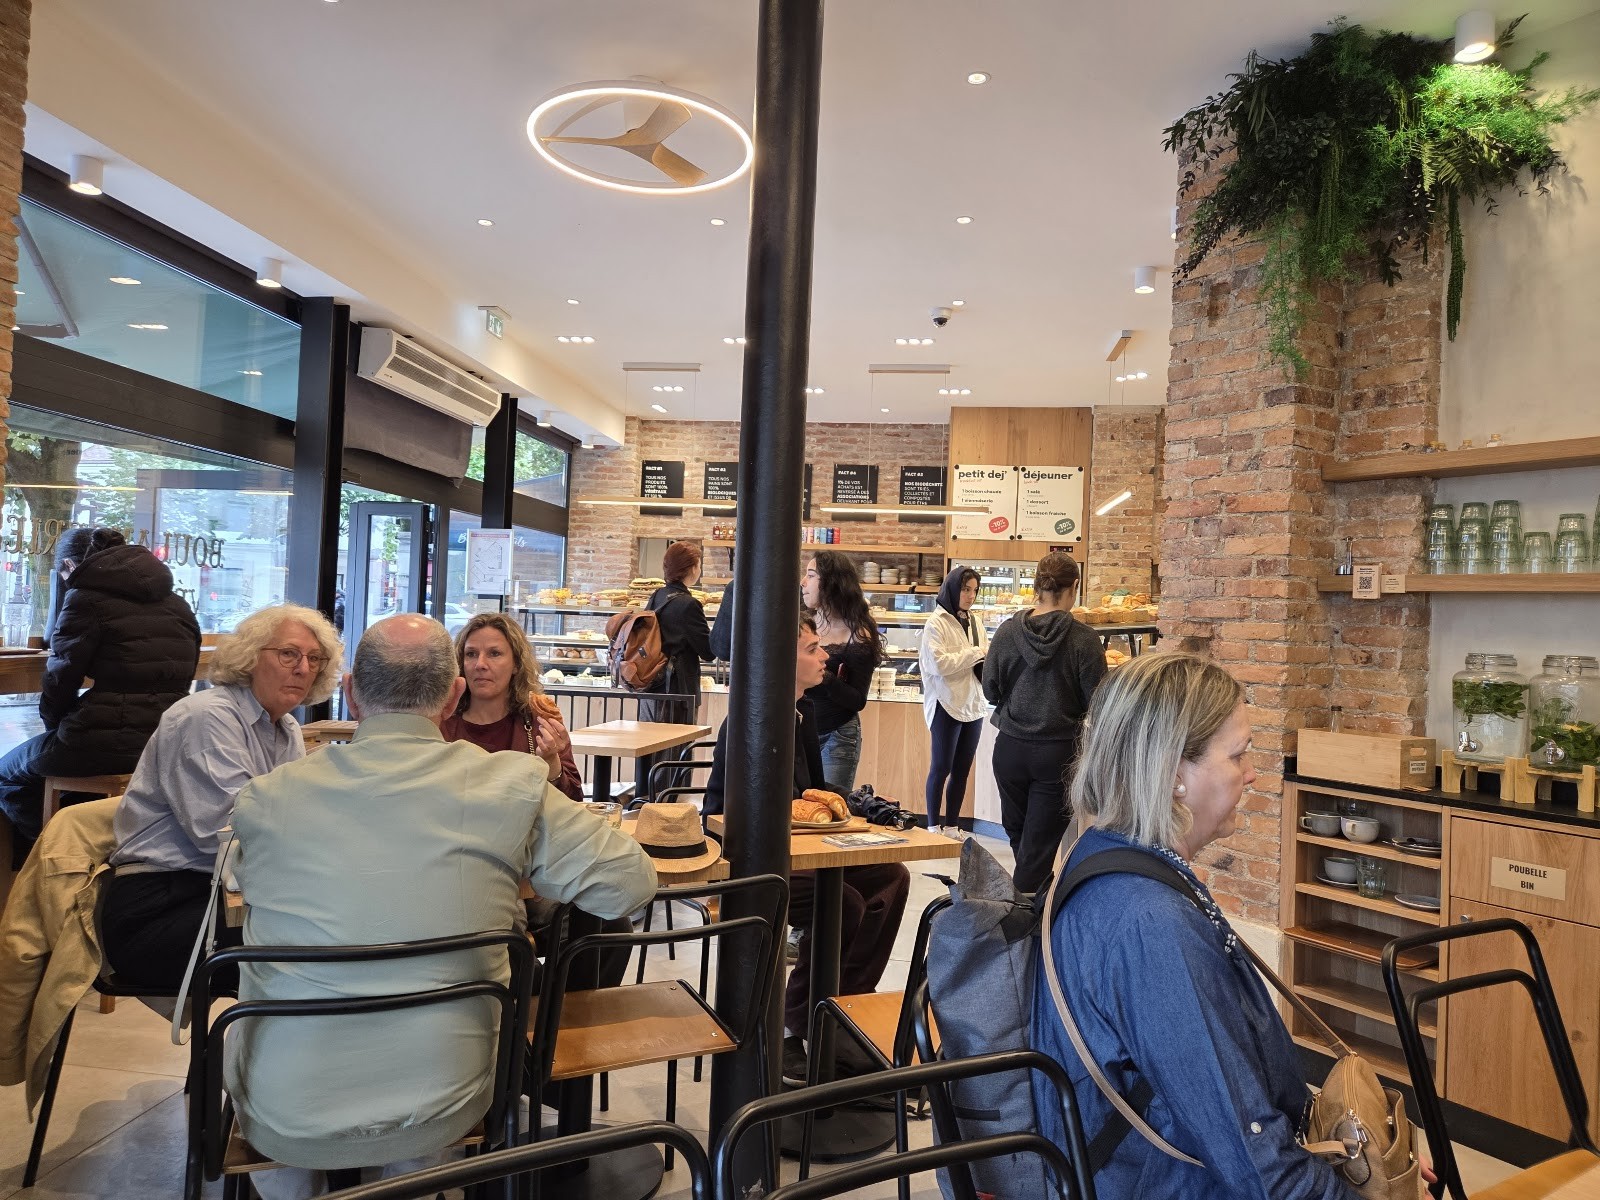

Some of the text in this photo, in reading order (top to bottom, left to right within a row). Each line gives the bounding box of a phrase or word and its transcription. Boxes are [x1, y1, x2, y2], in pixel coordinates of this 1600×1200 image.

[958, 470, 985, 480] petit
[1023, 470, 1073, 481] déjeuner
[1509, 864, 1547, 878] POUBELLE
[1520, 880, 1534, 890] BIN
